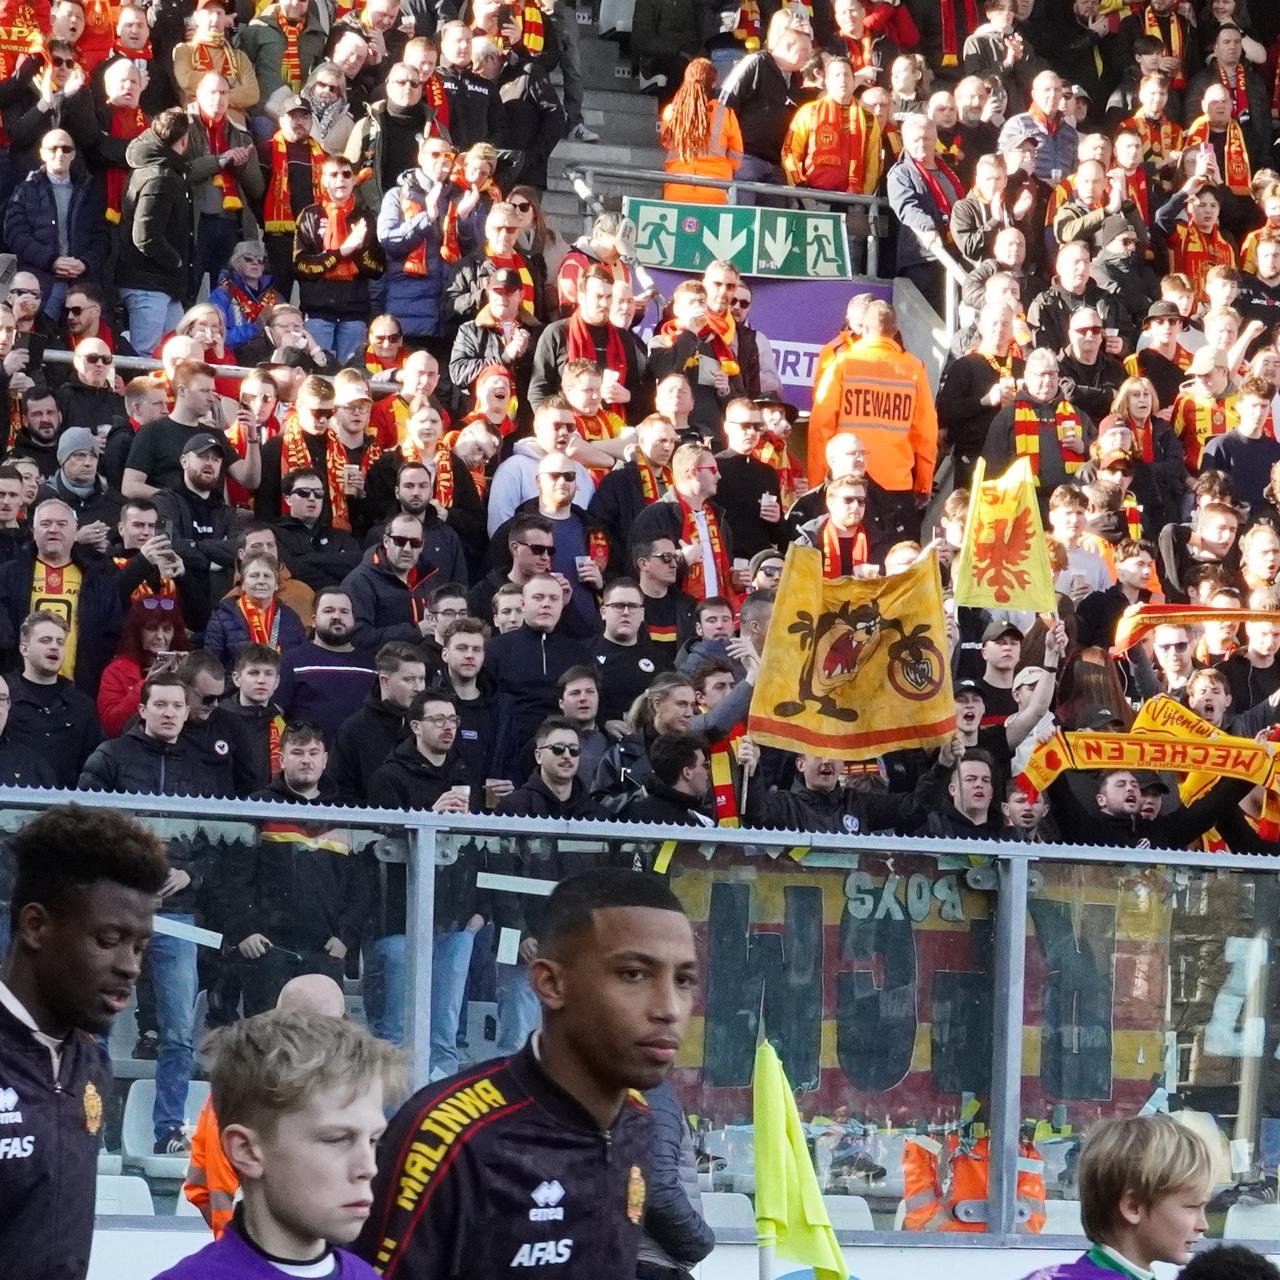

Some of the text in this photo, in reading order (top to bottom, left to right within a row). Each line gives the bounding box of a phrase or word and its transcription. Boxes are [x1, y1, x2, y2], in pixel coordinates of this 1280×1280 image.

[843, 388, 913, 423] STEWARD
[1083, 740, 1261, 774] MECHELEN
[843, 870, 965, 923] BOYS
[397, 1078, 508, 1211] MALINWA
[510, 1239, 573, 1267] AFAS
